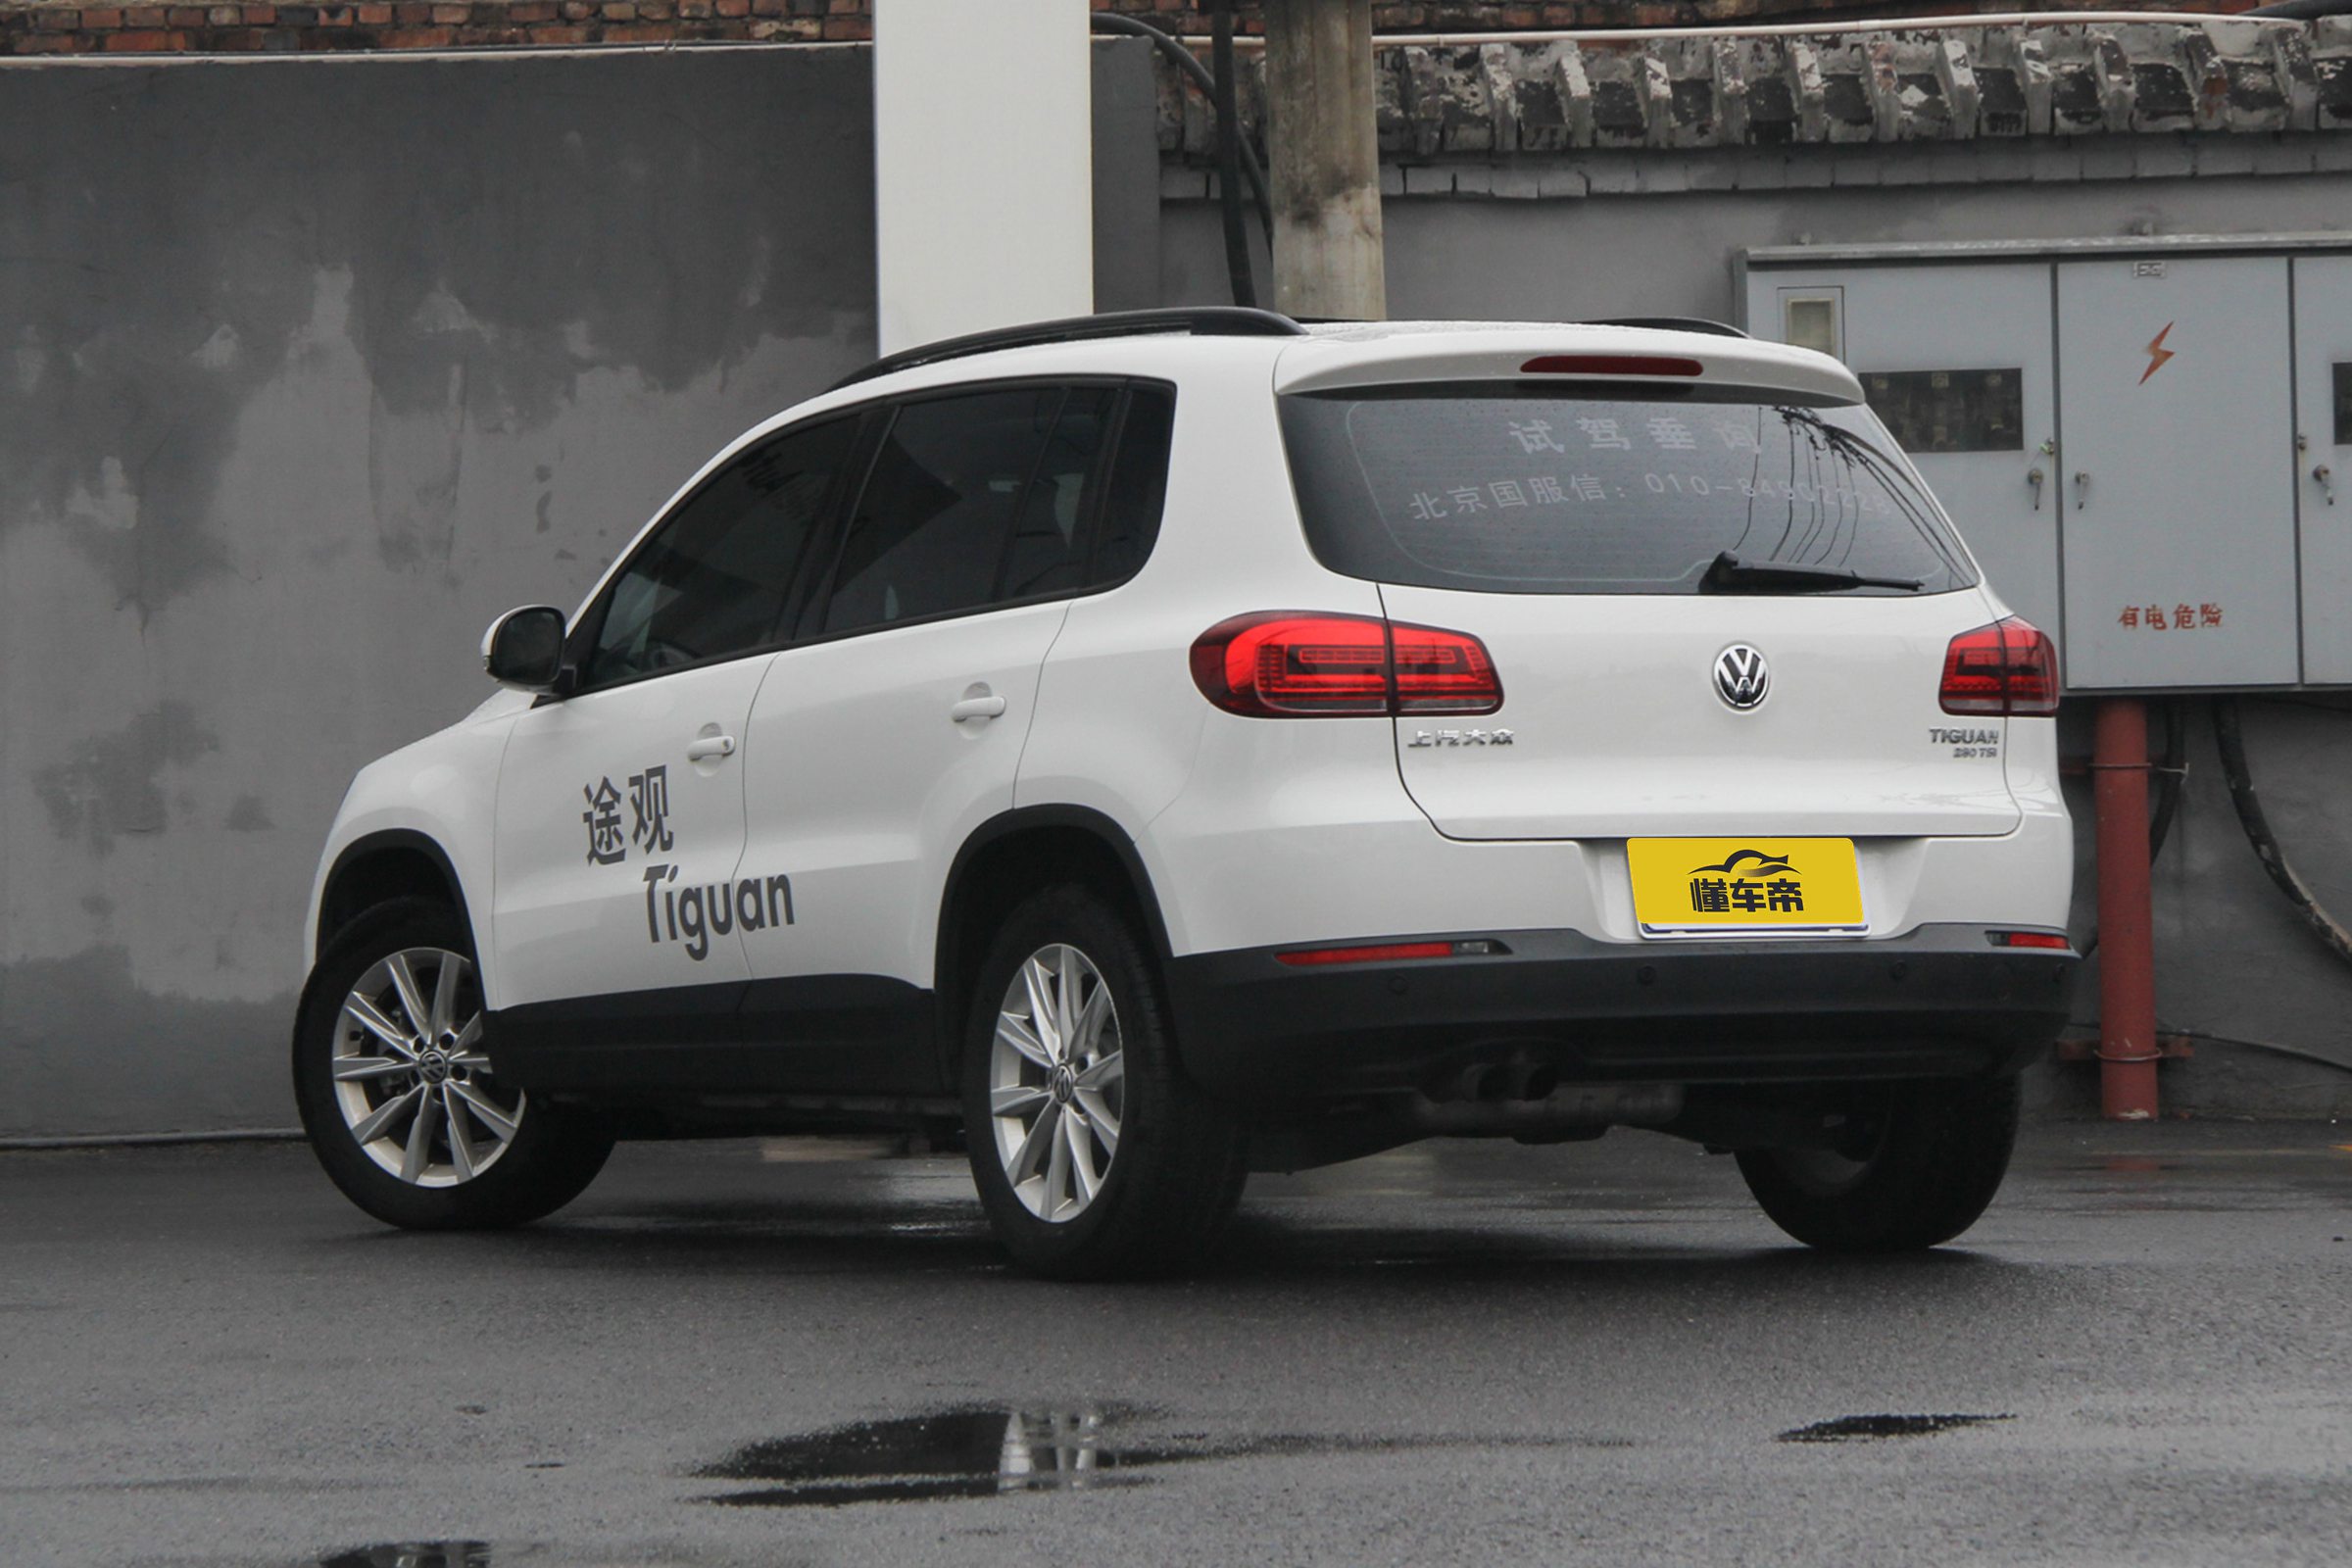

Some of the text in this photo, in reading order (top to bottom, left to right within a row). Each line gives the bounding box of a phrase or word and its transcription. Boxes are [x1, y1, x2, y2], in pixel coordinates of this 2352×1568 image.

[1507, 416, 1762, 454] 试驾垂询
[2118, 604, 2224, 630] 有电危险
[1929, 727, 1999, 745] TIGUAN
[583, 764, 674, 866] 途观
[643, 863, 795, 961] Tiguan
